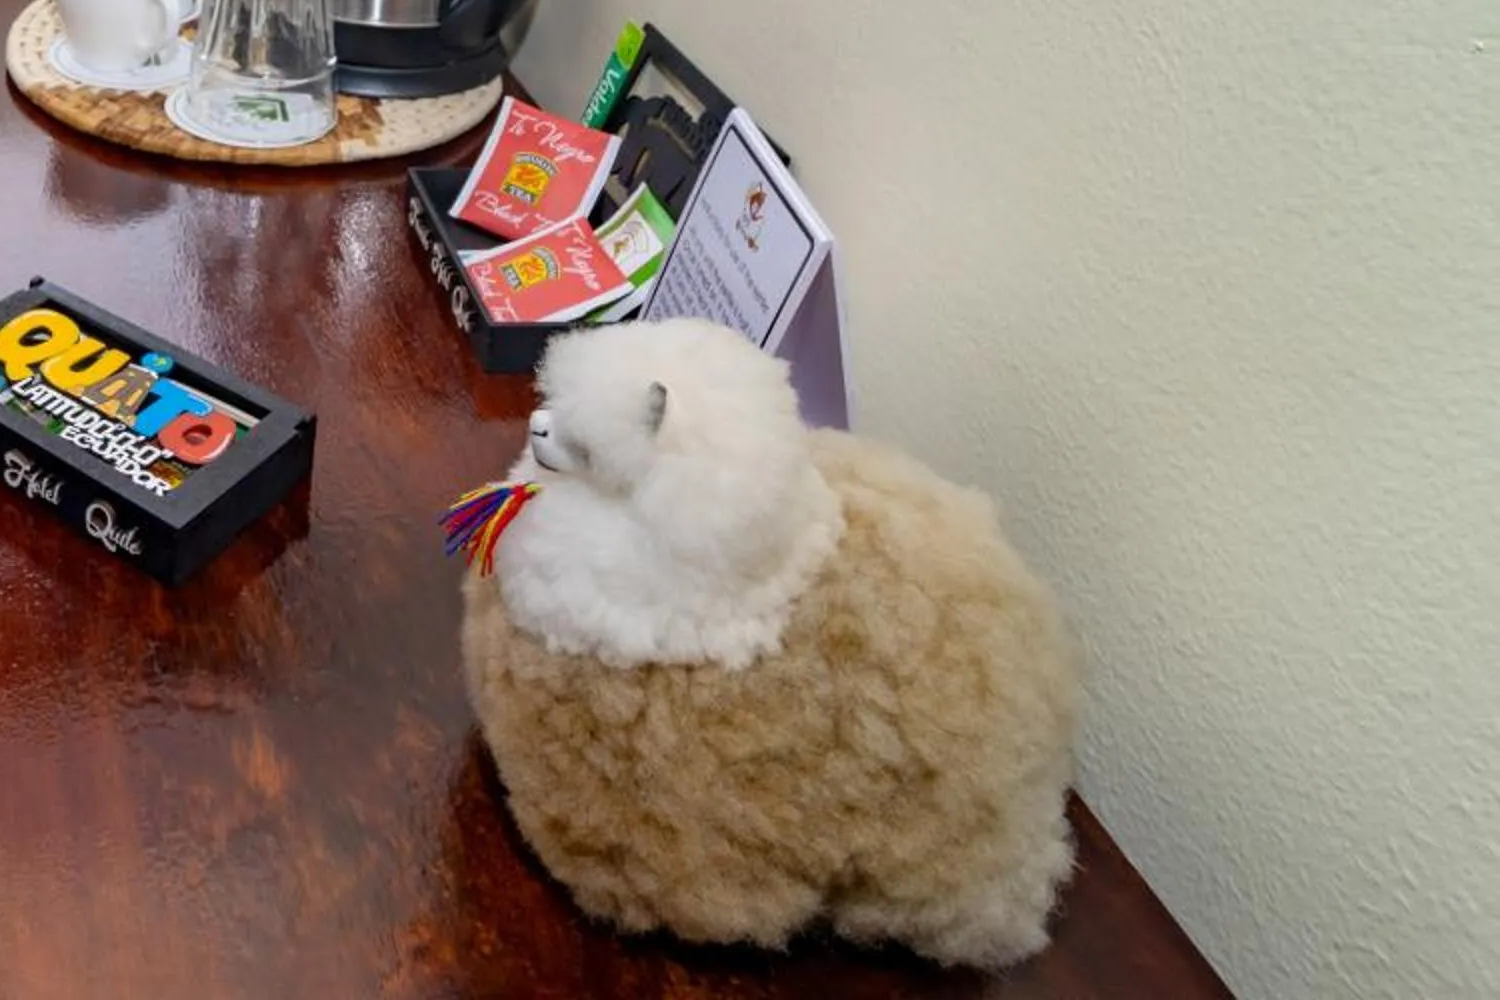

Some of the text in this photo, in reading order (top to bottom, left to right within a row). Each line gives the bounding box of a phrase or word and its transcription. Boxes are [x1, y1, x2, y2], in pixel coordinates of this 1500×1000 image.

[533, 120, 596, 164] Negro
[60, 425, 174, 498] ECUADOR
[3, 448, 66, 506] Hotel
[85, 500, 142, 556] Quito
